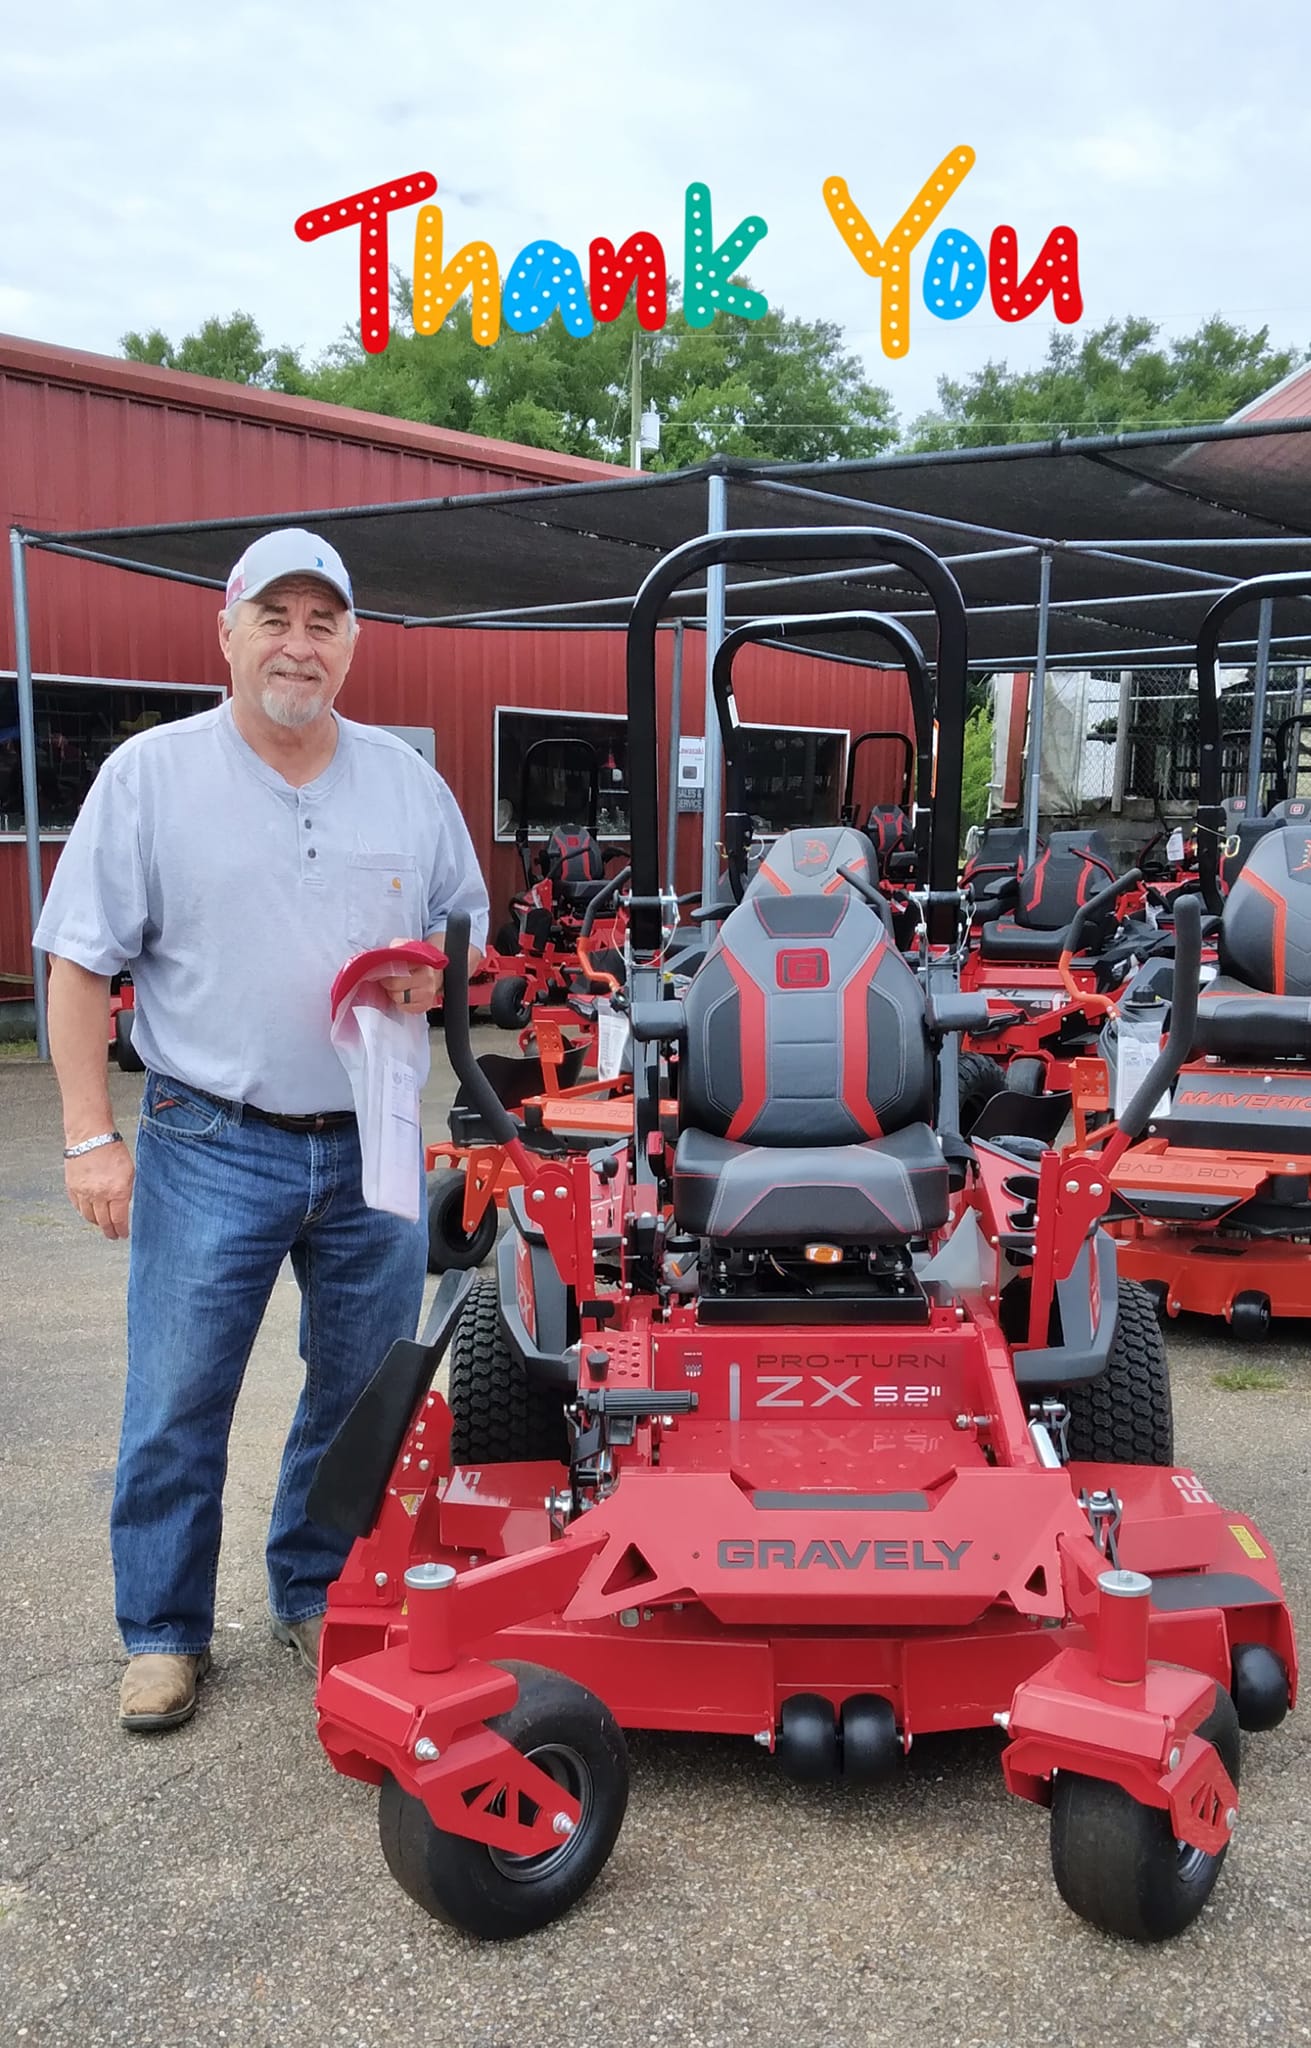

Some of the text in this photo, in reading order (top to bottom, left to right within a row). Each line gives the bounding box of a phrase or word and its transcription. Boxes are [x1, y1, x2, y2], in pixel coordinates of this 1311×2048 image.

[1117, 1162, 1247, 1179] BAD BOY
[757, 1354, 946, 1368] PRO-TURN
[756, 1376, 863, 1407] ZX
[717, 1540, 974, 1570] GRAVELY
